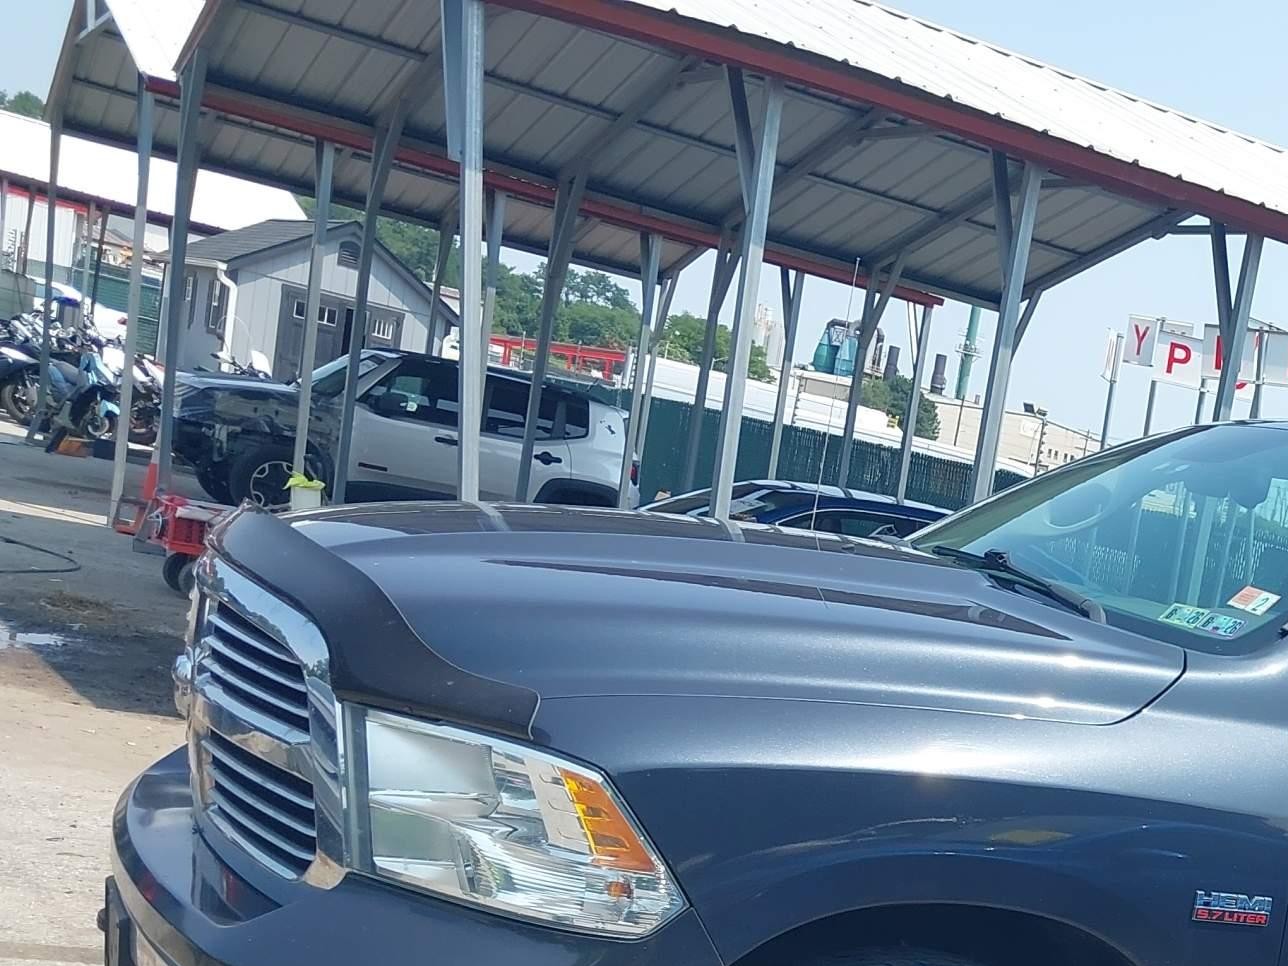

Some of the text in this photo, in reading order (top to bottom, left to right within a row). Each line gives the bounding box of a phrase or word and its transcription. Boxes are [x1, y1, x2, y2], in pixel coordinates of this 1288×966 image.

[1134, 323, 1150, 357] Y
[1165, 341, 1192, 374] P
[1194, 889, 1274, 913] HEMI
[1196, 909, 1268, 925] 5.7 LITER
